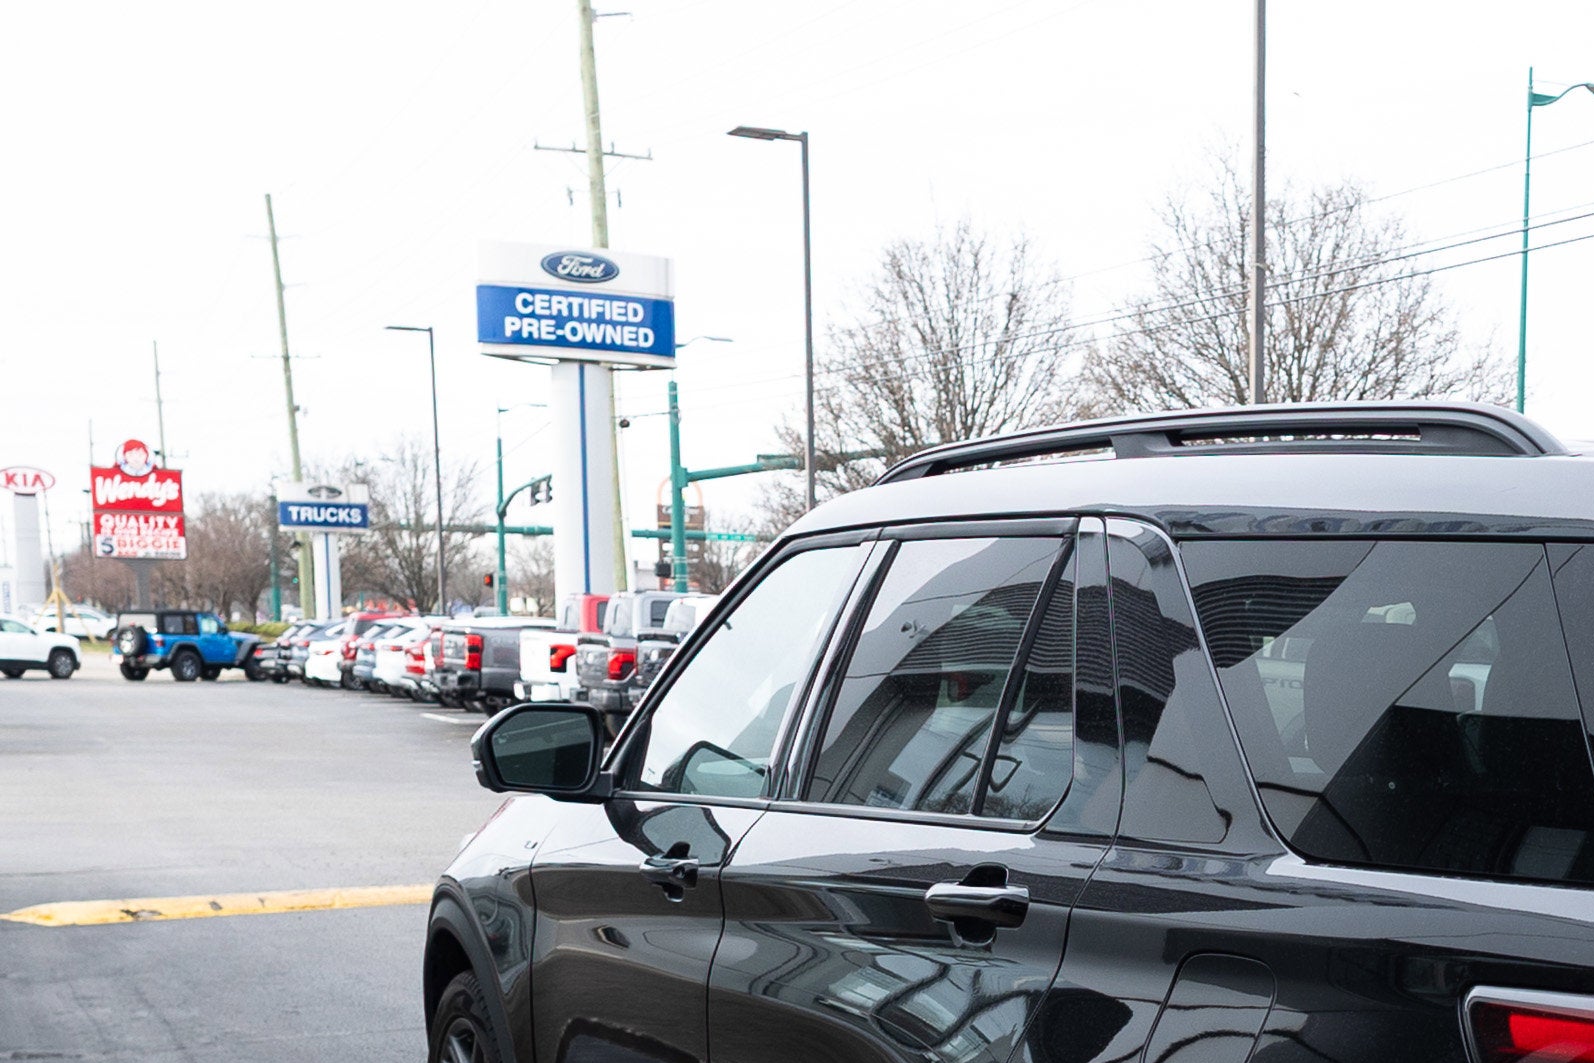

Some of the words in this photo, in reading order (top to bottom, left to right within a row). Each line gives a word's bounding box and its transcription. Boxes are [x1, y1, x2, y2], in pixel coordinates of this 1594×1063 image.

[557, 255, 605, 278] Ford
[515, 292, 645, 323] CERTIFIED
[504, 316, 655, 348] PRE-OWNED
[5, 472, 45, 487] KIA
[95, 473, 179, 507] Wendy's
[100, 514, 178, 530] QUALITY
[288, 506, 362, 524] TRUCKS
